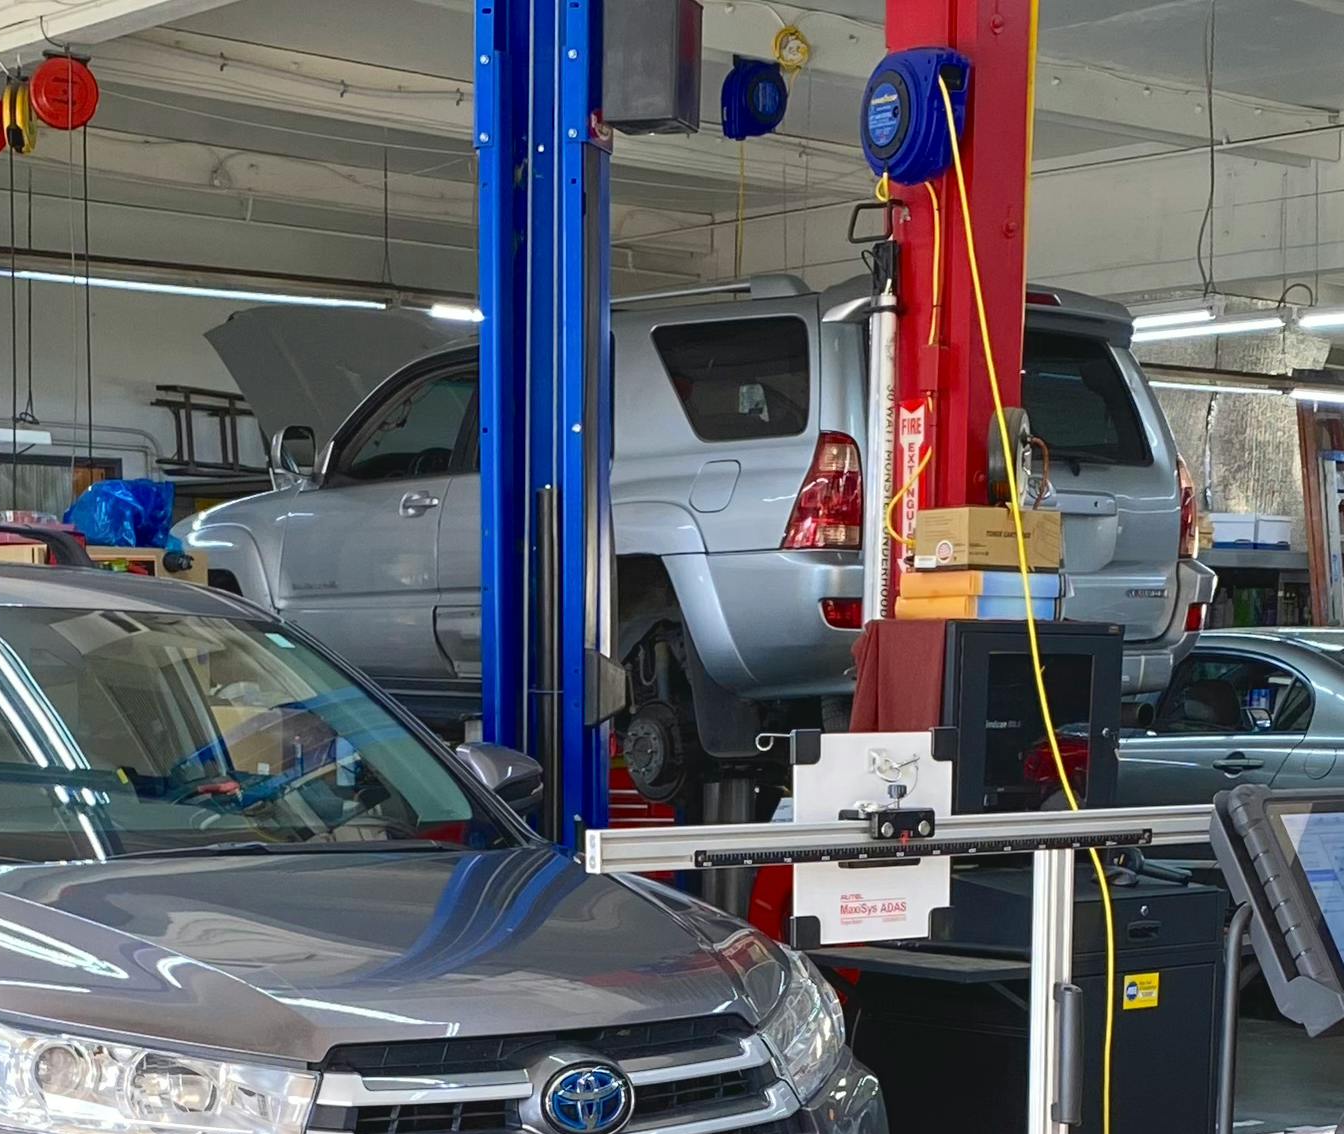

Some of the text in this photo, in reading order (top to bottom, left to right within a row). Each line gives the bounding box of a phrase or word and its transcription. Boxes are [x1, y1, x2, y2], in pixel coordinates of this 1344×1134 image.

[902, 417, 922, 435] FIRE
[840, 901, 907, 914] MaxiSys ADAS
